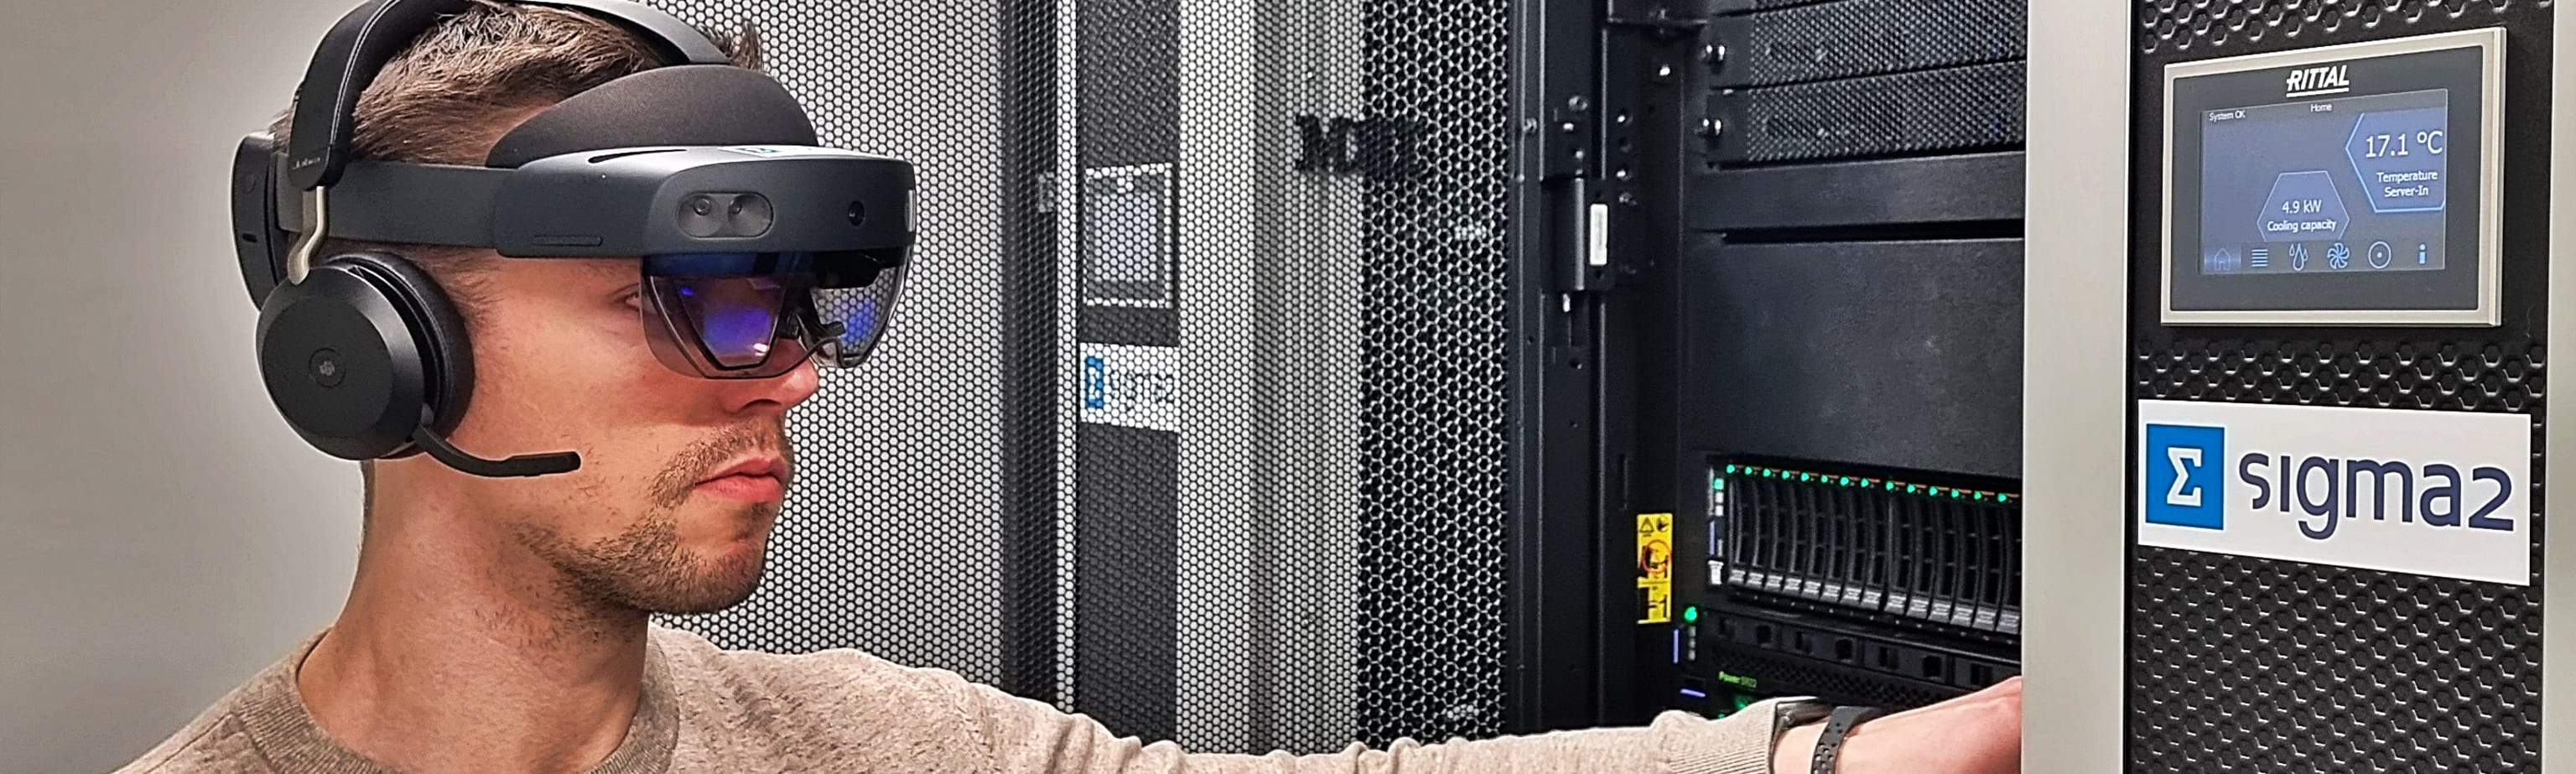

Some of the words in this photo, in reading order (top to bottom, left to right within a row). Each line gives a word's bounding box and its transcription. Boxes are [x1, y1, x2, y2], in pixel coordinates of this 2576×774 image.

[2286, 65, 2350, 91] RITTAL
[2310, 103, 2332, 112] Home
[2209, 112, 2233, 122] System
[2235, 110, 2246, 119] OK
[2365, 134, 2409, 158] 17.1
[2417, 131, 2443, 154] °C
[2376, 171, 2438, 184] Temperature
[2384, 185, 2429, 198] Server-In
[2282, 201, 2300, 214] 4.9
[2303, 200, 2322, 213] kW
[2267, 221, 2298, 233] Cooling
[2301, 219, 2337, 232] capacity
[2239, 453, 2514, 540] sigma2
